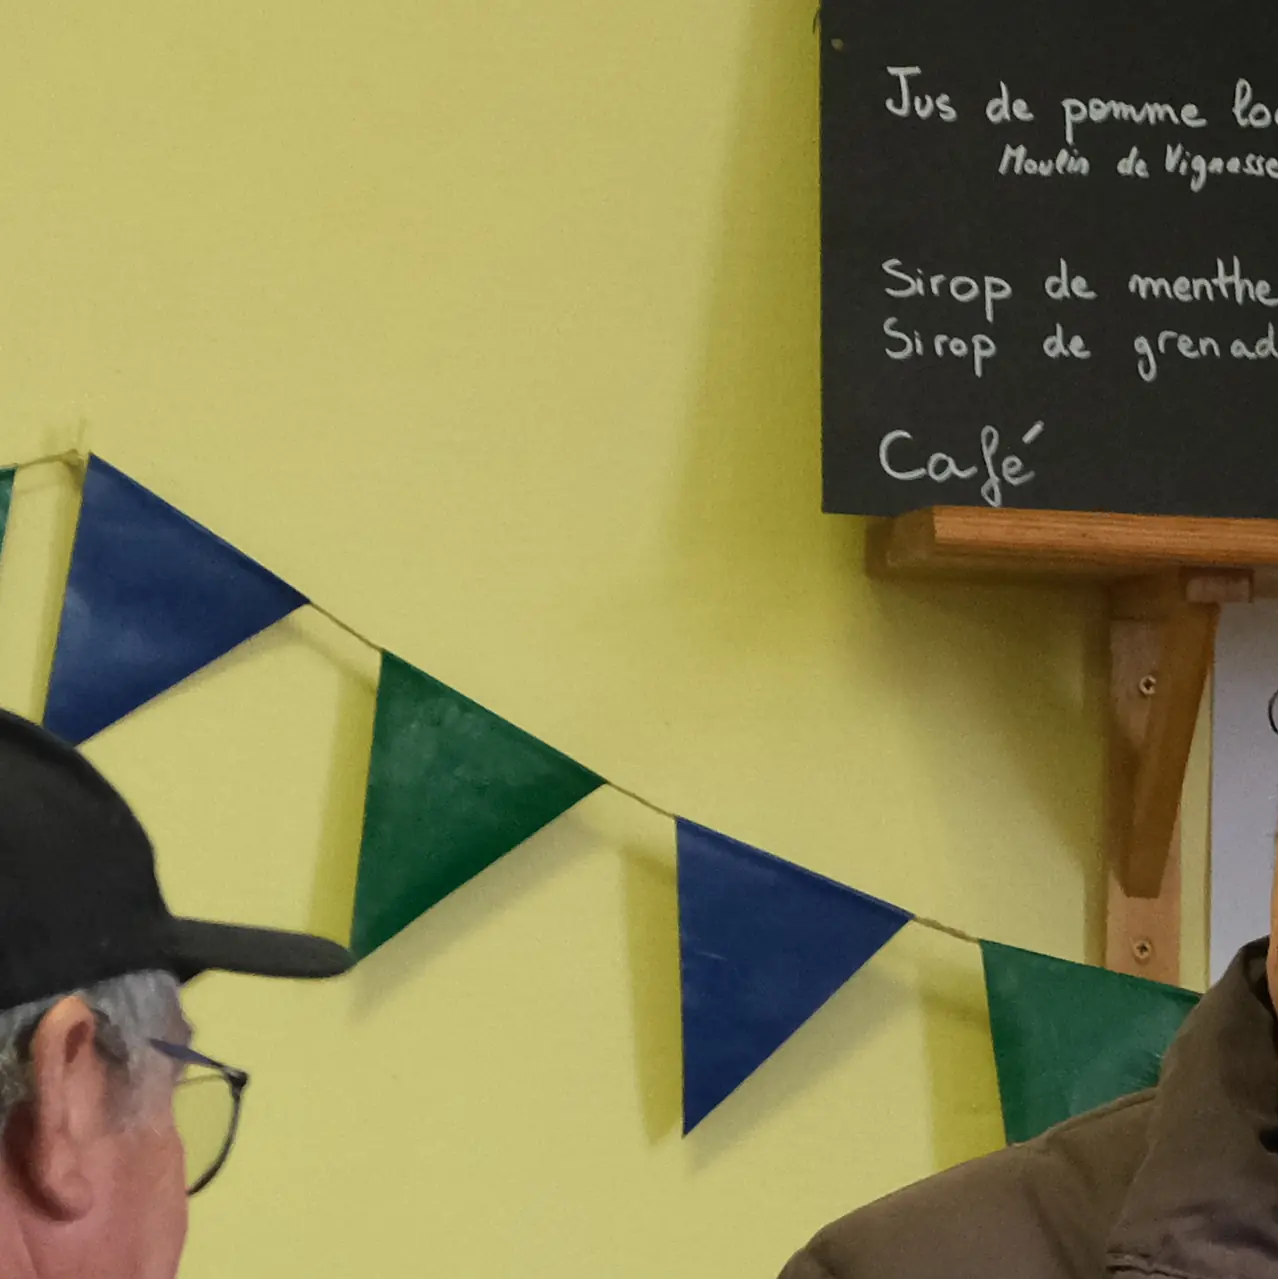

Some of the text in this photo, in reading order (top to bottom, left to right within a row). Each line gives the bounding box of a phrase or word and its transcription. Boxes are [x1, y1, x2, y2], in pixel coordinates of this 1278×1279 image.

[885, 65, 957, 122] Jus
[985, 80, 1034, 123] de
[1059, 98, 1207, 147] pomme
[998, 143, 1090, 177] Moulin
[1116, 146, 1149, 178] de
[881, 258, 1012, 322] Sirop
[1044, 257, 1096, 300] de
[883, 318, 996, 378] Sirop
[1042, 323, 1091, 359] de
[879, 420, 1045, 506] Café
